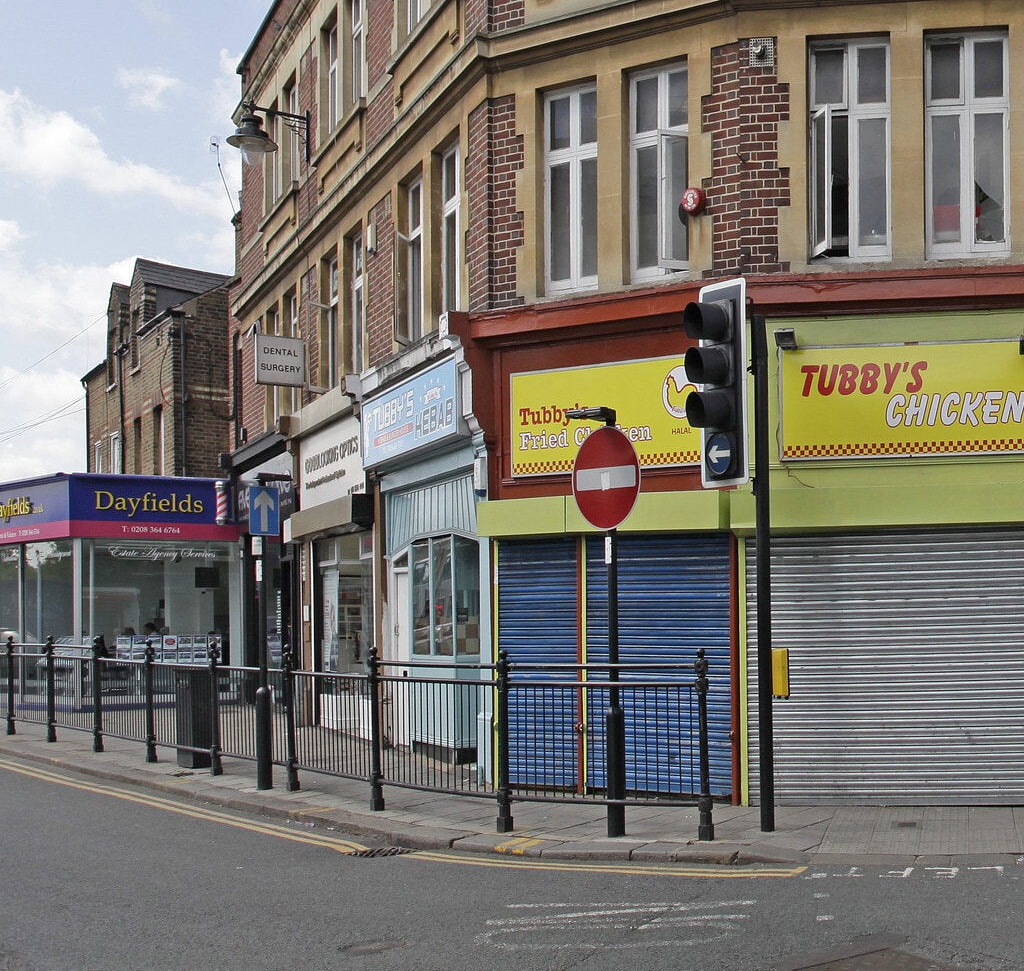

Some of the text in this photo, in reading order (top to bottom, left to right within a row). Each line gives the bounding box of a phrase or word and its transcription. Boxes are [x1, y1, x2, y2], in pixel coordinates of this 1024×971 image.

[263, 346, 299, 358] DENTAL
[260, 362, 301, 374] SURGERY
[801, 360, 928, 397] TUBBY'S
[372, 388, 415, 434] TUBBY'S
[414, 396, 454, 441] KEBAB
[519, 429, 569, 450] Fried
[671, 427, 693, 435] HALAL
[0, 495, 31, 523] ayfields
[94, 490, 204, 518] Dayfields
[122, 525, 181, 534] T: 0208 364 6764
